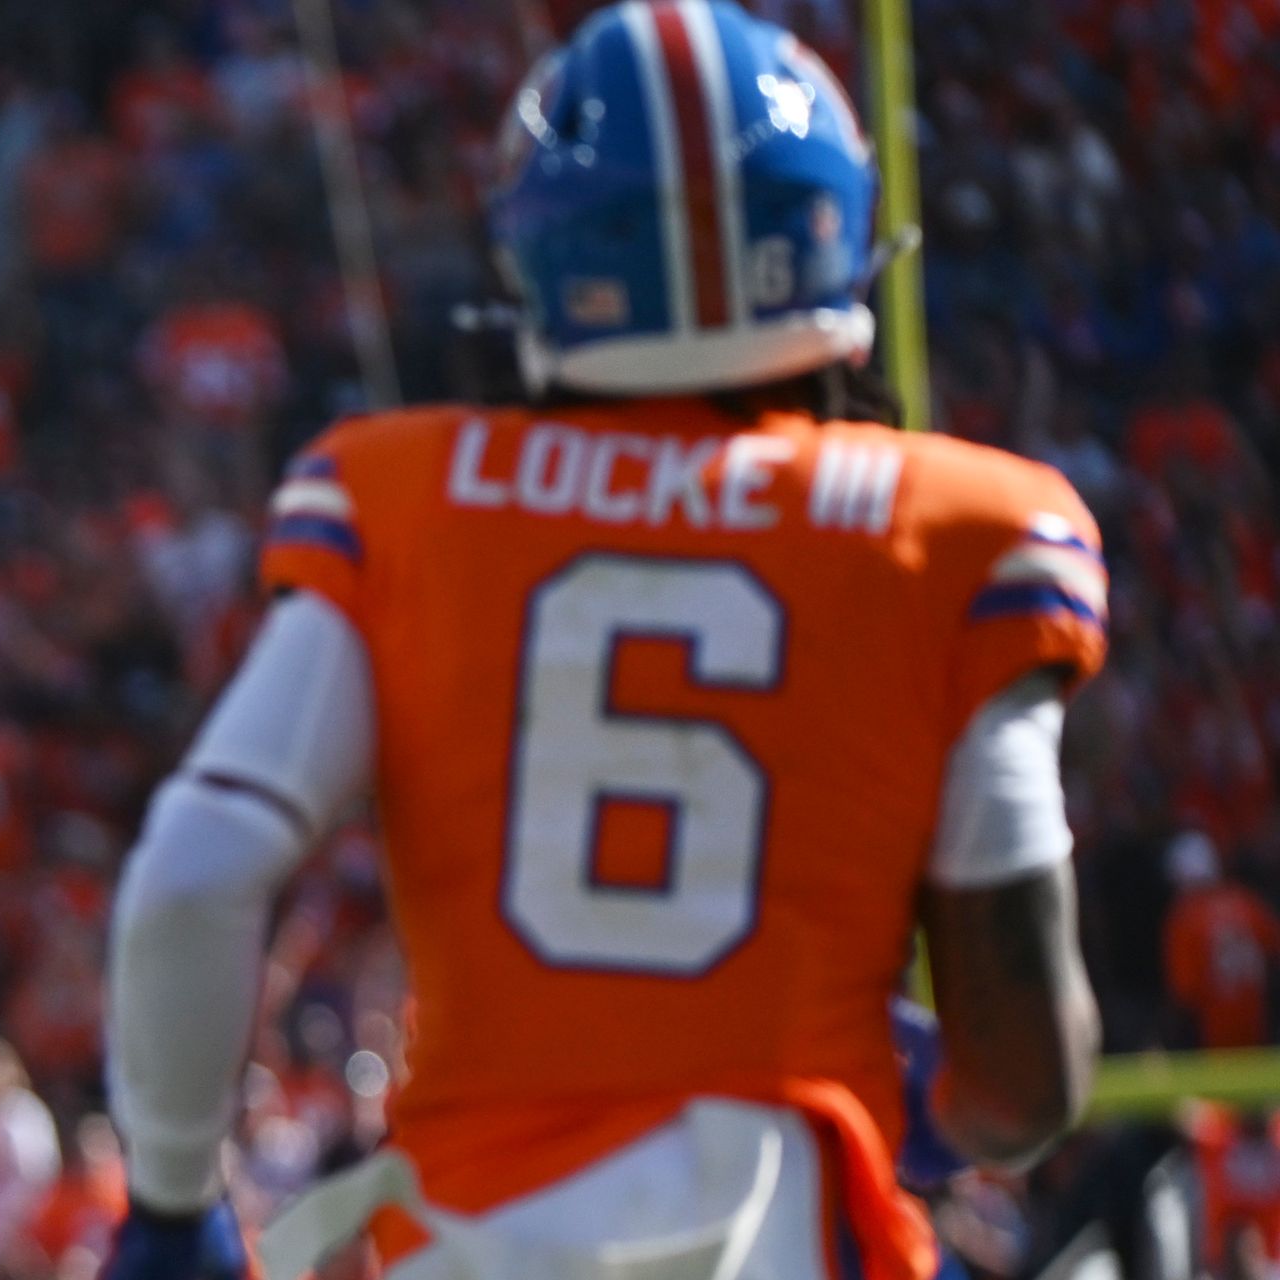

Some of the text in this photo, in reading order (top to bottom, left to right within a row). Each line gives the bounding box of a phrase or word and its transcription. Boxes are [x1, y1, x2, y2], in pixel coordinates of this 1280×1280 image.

[448, 415, 904, 538] LOCKE III
[500, 552, 787, 978] 6
